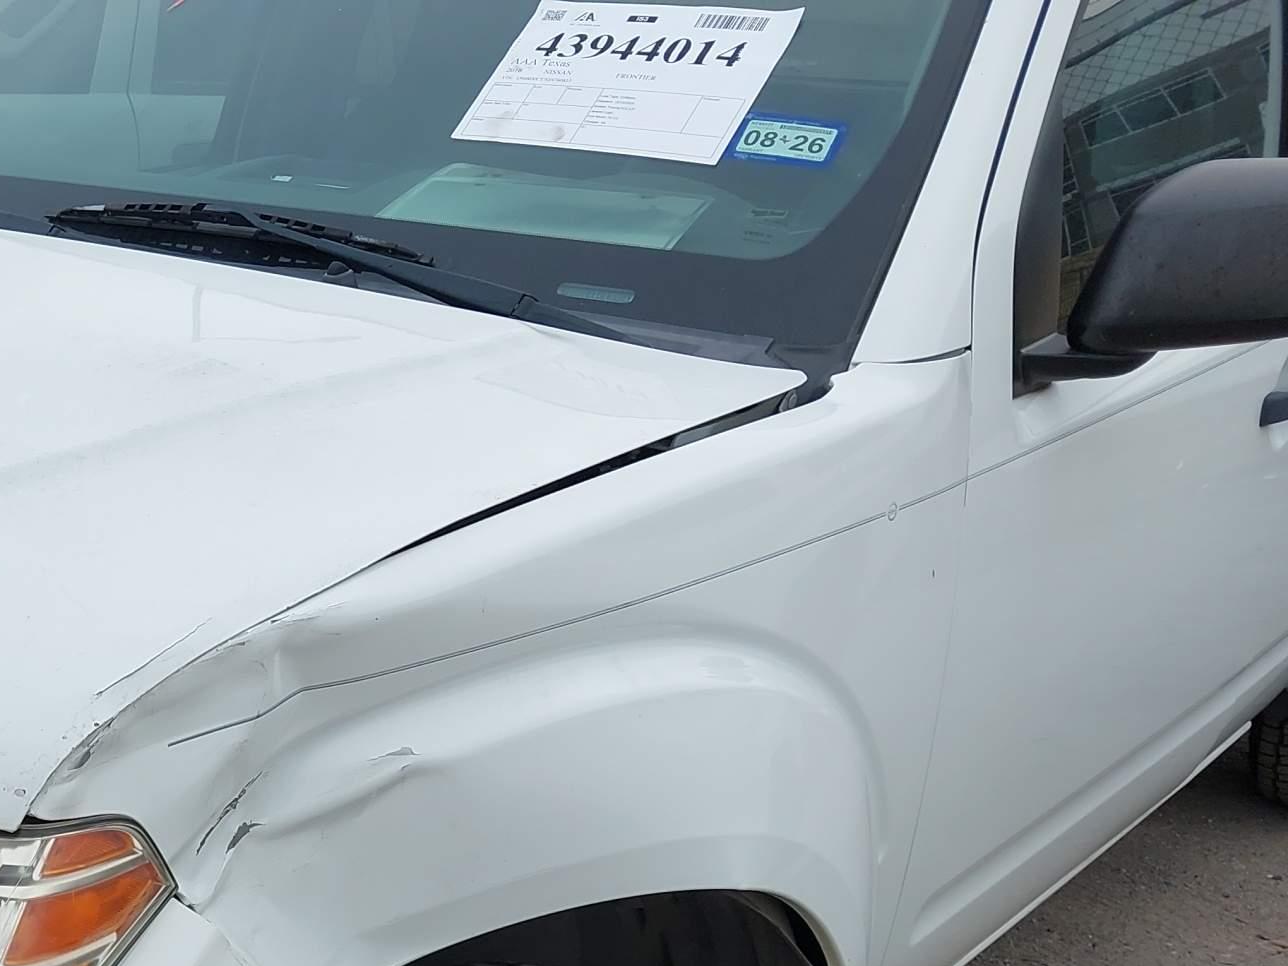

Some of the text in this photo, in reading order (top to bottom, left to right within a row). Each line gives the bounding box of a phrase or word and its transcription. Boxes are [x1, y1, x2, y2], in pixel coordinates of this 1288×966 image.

[535, 32, 748, 67] 43944014
[542, 58, 572, 68] Texas
[615, 72, 657, 81] FRONTIER
